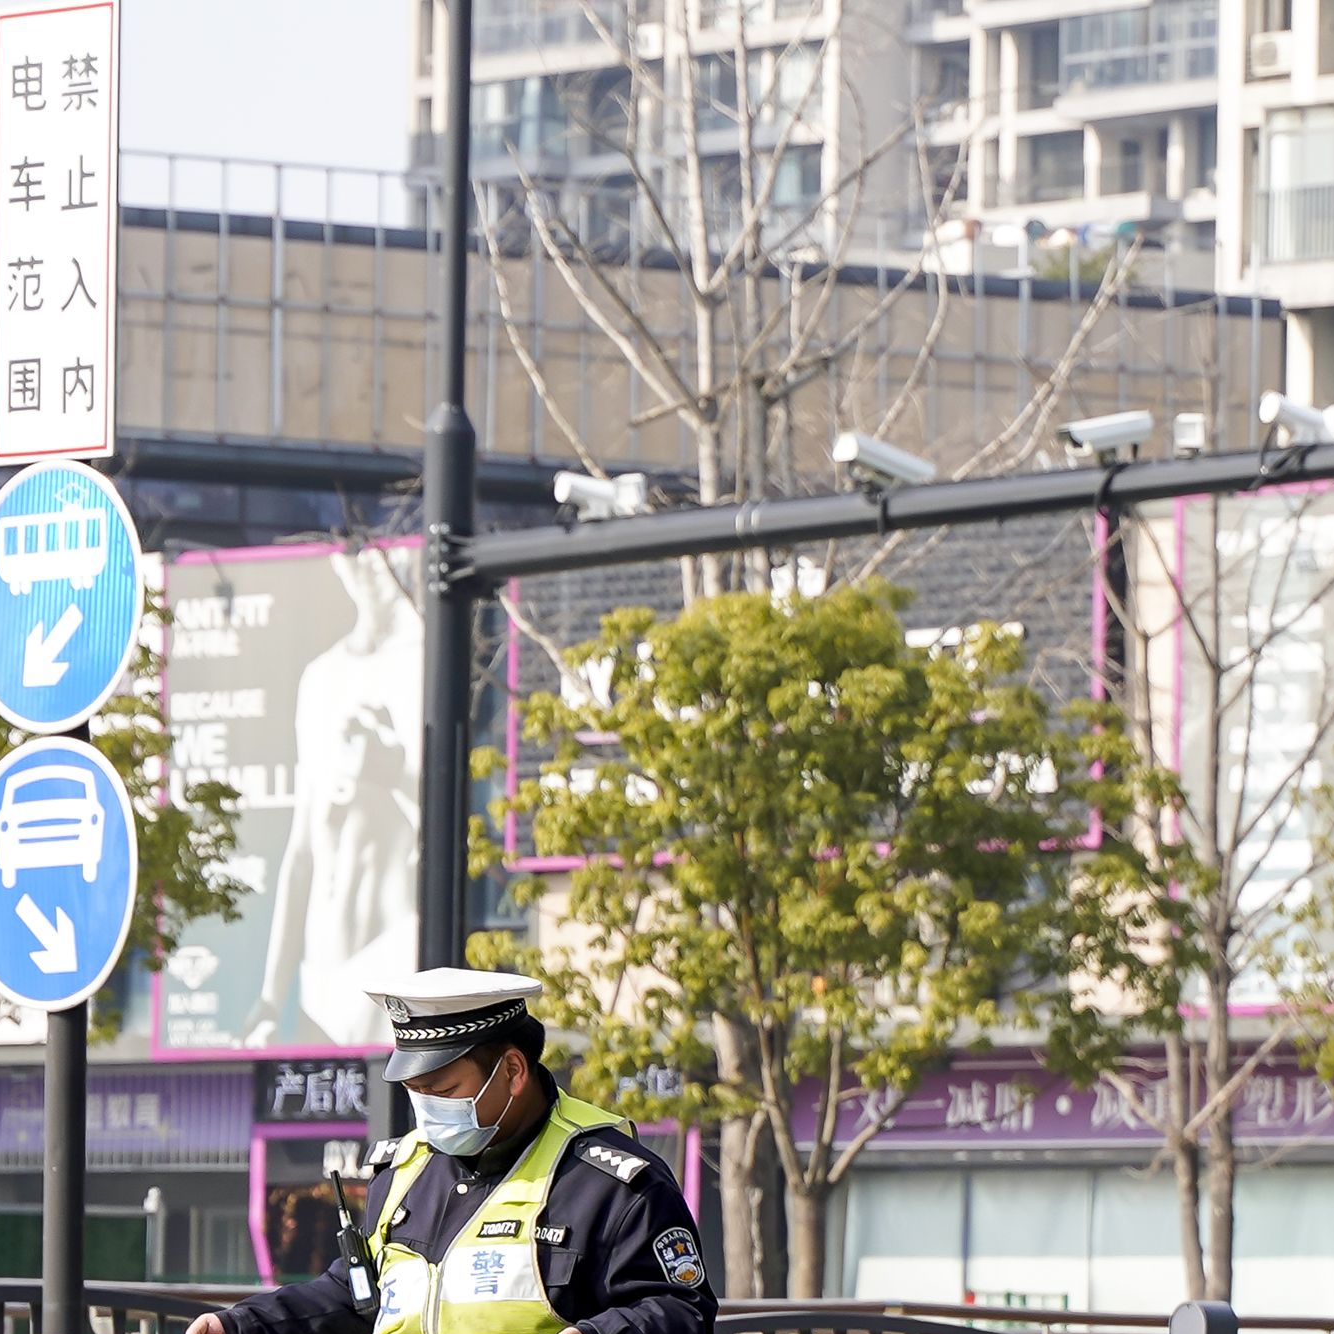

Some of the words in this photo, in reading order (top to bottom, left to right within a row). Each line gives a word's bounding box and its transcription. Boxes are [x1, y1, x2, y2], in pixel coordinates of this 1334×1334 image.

[7, 55, 47, 414] 电车范围
[61, 53, 99, 414] 禁止入内
[171, 689, 266, 720] BECAUSE
[471, 1250, 506, 1296] 警
